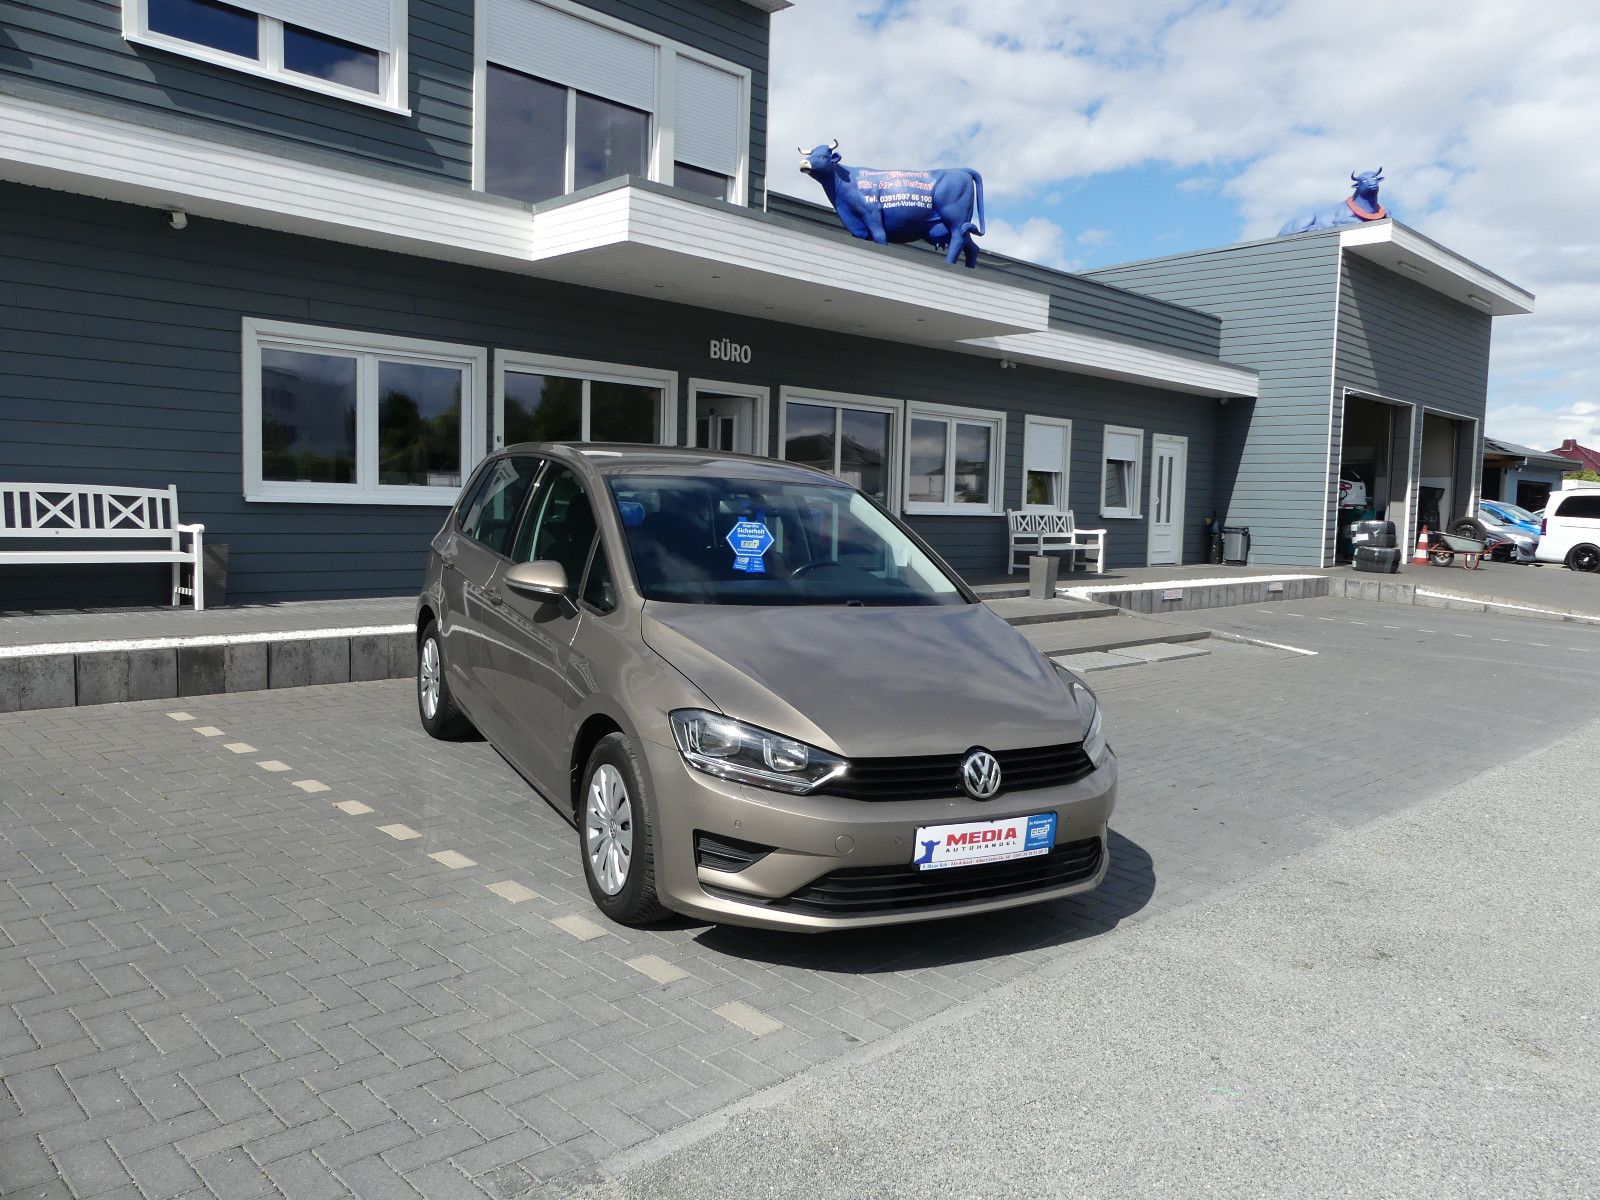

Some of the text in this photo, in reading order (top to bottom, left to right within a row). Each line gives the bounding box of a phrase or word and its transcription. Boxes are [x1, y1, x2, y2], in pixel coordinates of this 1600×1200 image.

[864, 195, 878, 203] Tel.
[709, 338, 752, 364] BÜRO
[946, 827, 1017, 847] MEDIA
[946, 841, 1017, 853] AUTOHANDEL
